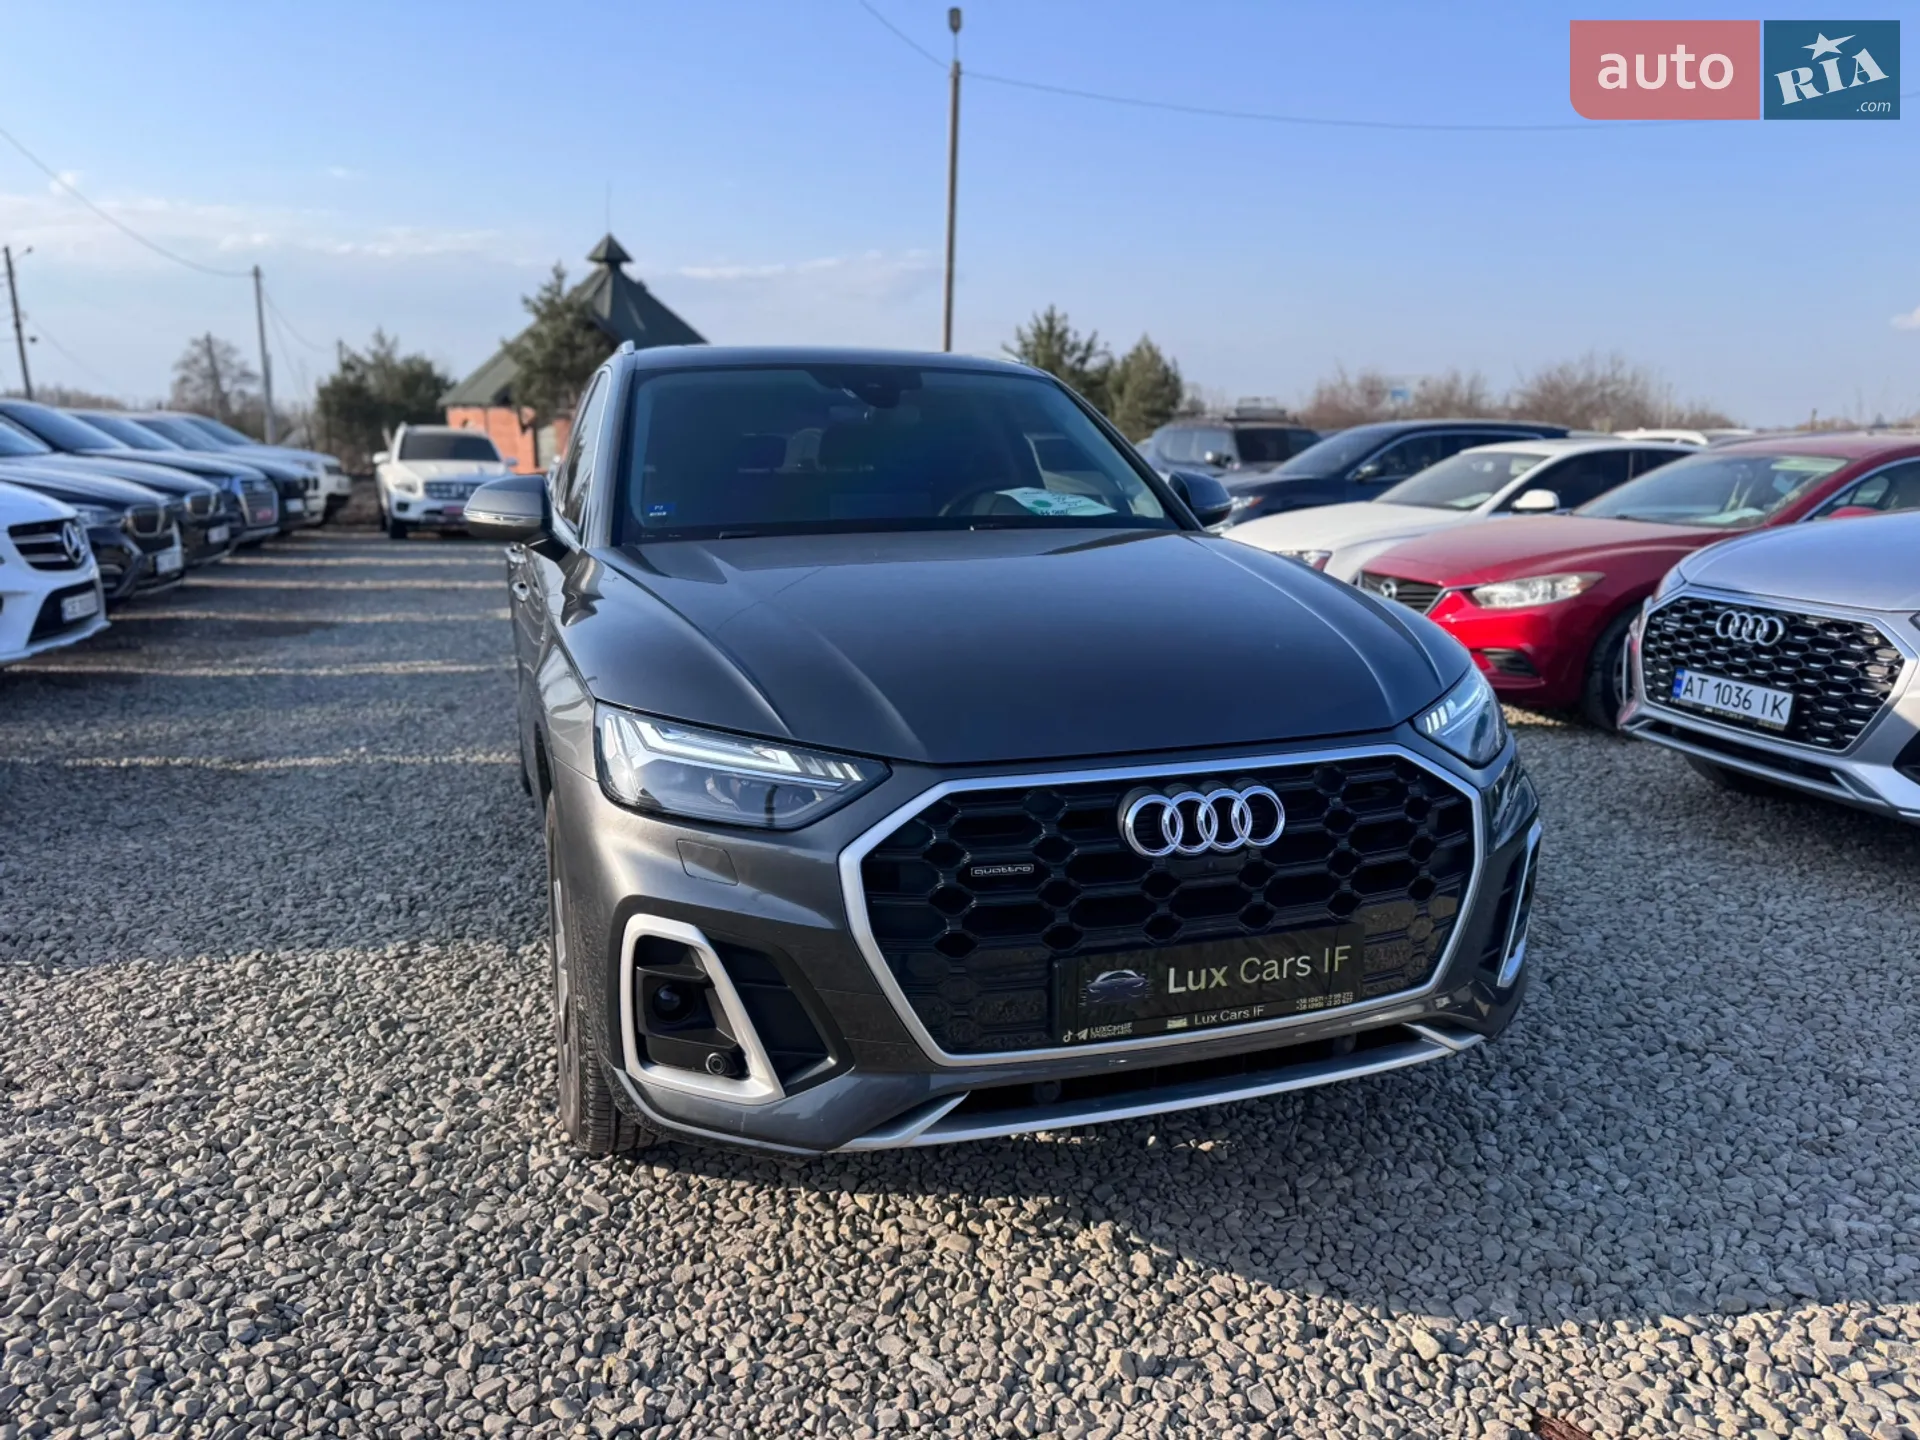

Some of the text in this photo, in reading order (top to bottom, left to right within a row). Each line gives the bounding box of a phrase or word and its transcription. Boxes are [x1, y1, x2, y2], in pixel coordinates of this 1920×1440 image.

[1683, 675, 1788, 720] AT 1036 IK
[974, 865, 1031, 876] quattro
[1168, 945, 1352, 993] Lux Cars IF
[1194, 1005, 1265, 1025] Lux Cars IF
